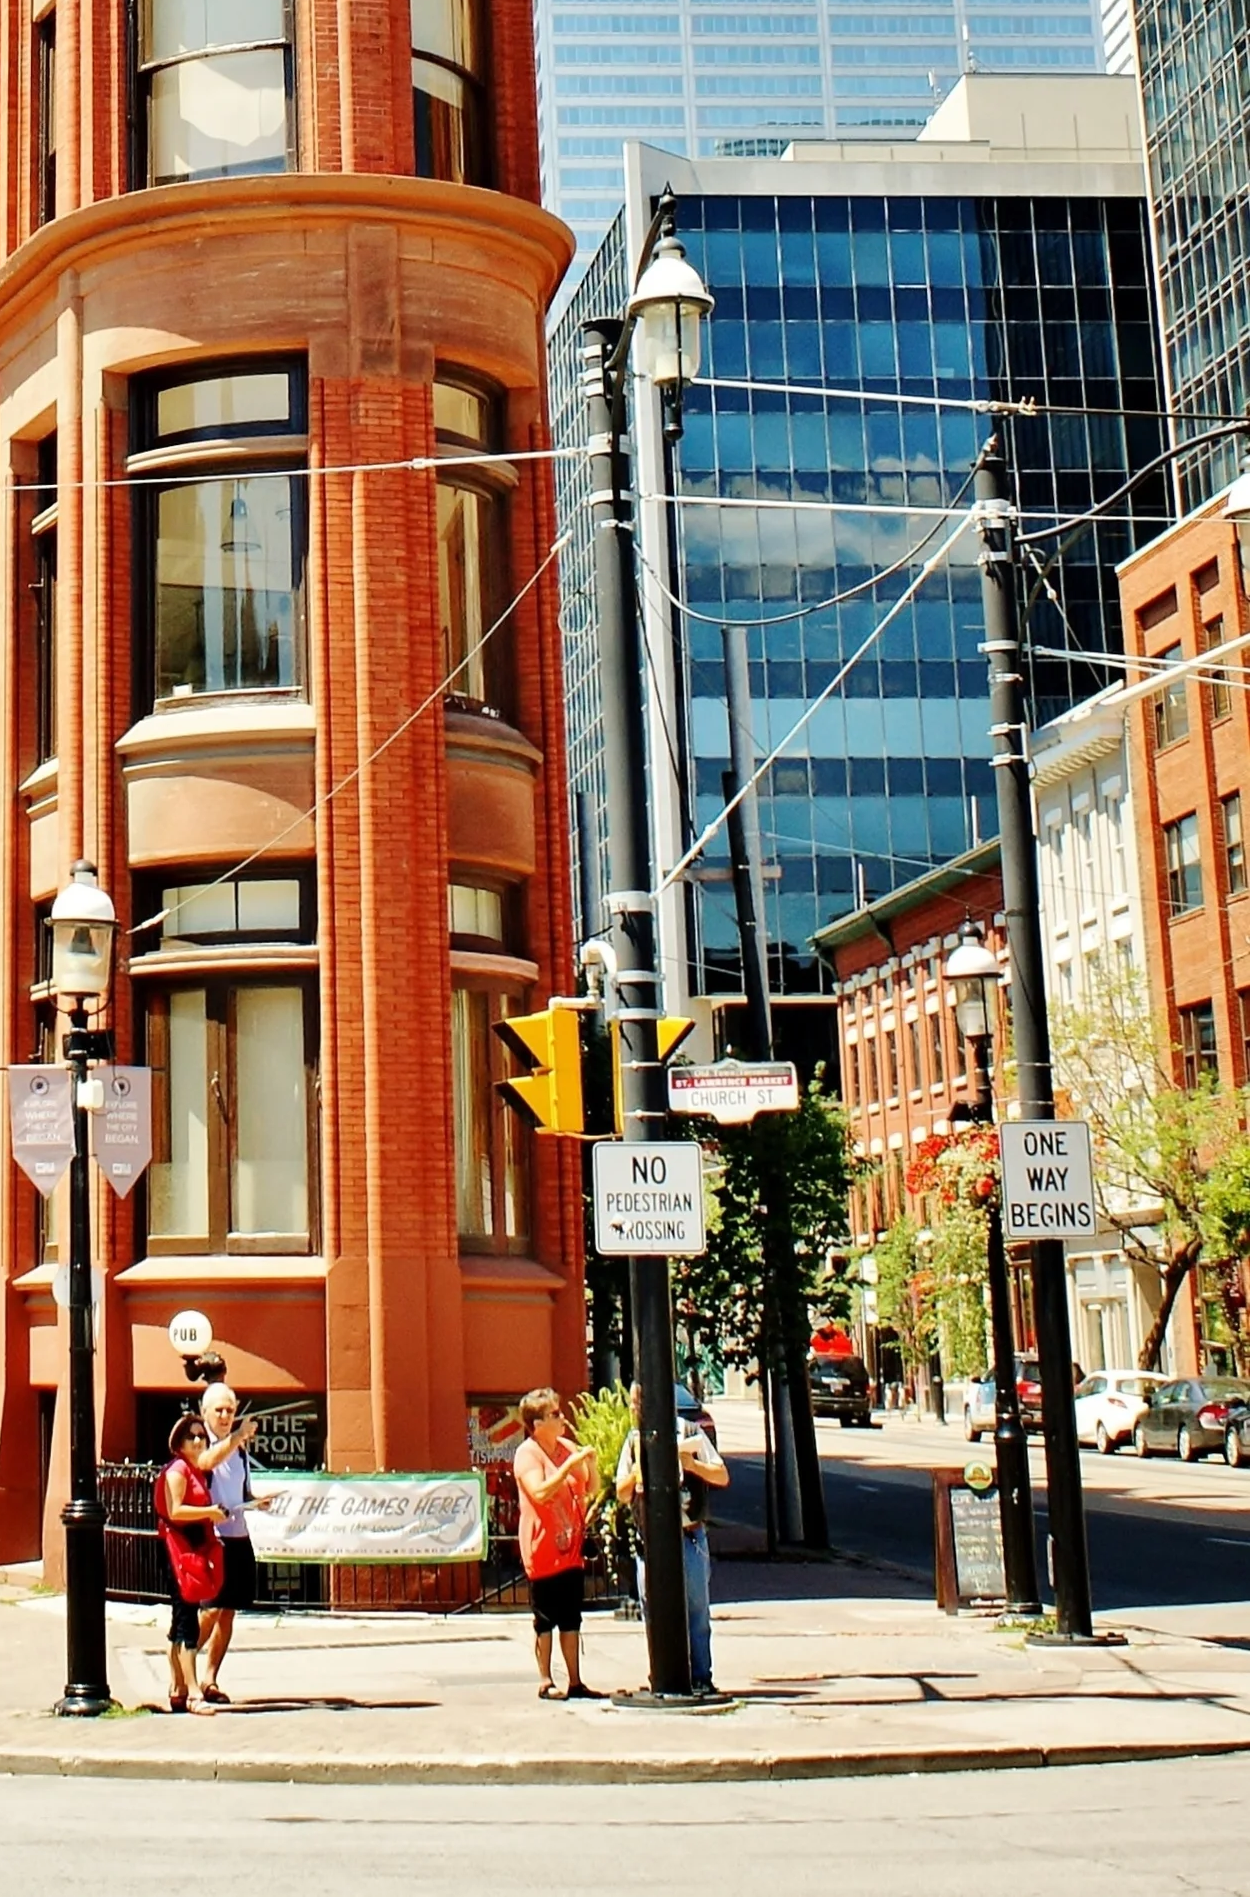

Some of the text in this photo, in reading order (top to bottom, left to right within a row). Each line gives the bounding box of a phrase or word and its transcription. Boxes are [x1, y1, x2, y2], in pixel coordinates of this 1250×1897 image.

[693, 1077, 747, 1088] LAWRENCE
[749, 1076, 790, 1086] MARKET
[690, 1090, 746, 1106] CHURCH
[24, 1110, 58, 1120] WHERE
[106, 1111, 138, 1121] WHERE
[25, 1122, 42, 1130] THE
[106, 1123, 138, 1132] THE CITY
[25, 1132, 61, 1143] BEGAN
[104, 1134, 139, 1144] BEGAN
[1024, 1131, 1068, 1156] ONE
[632, 1156, 666, 1184] NO
[1026, 1167, 1069, 1192] WAY
[606, 1193, 692, 1212] PEDESTRIAN
[1010, 1202, 1091, 1227] BEGINS
[618, 1220, 685, 1240] ROSSING
[173, 1328, 197, 1341] PUB
[258, 1414, 306, 1433] THE
[298, 1496, 336, 1516] THE
[340, 1495, 410, 1517] GAMES
[413, 1493, 473, 1516] HERE!
